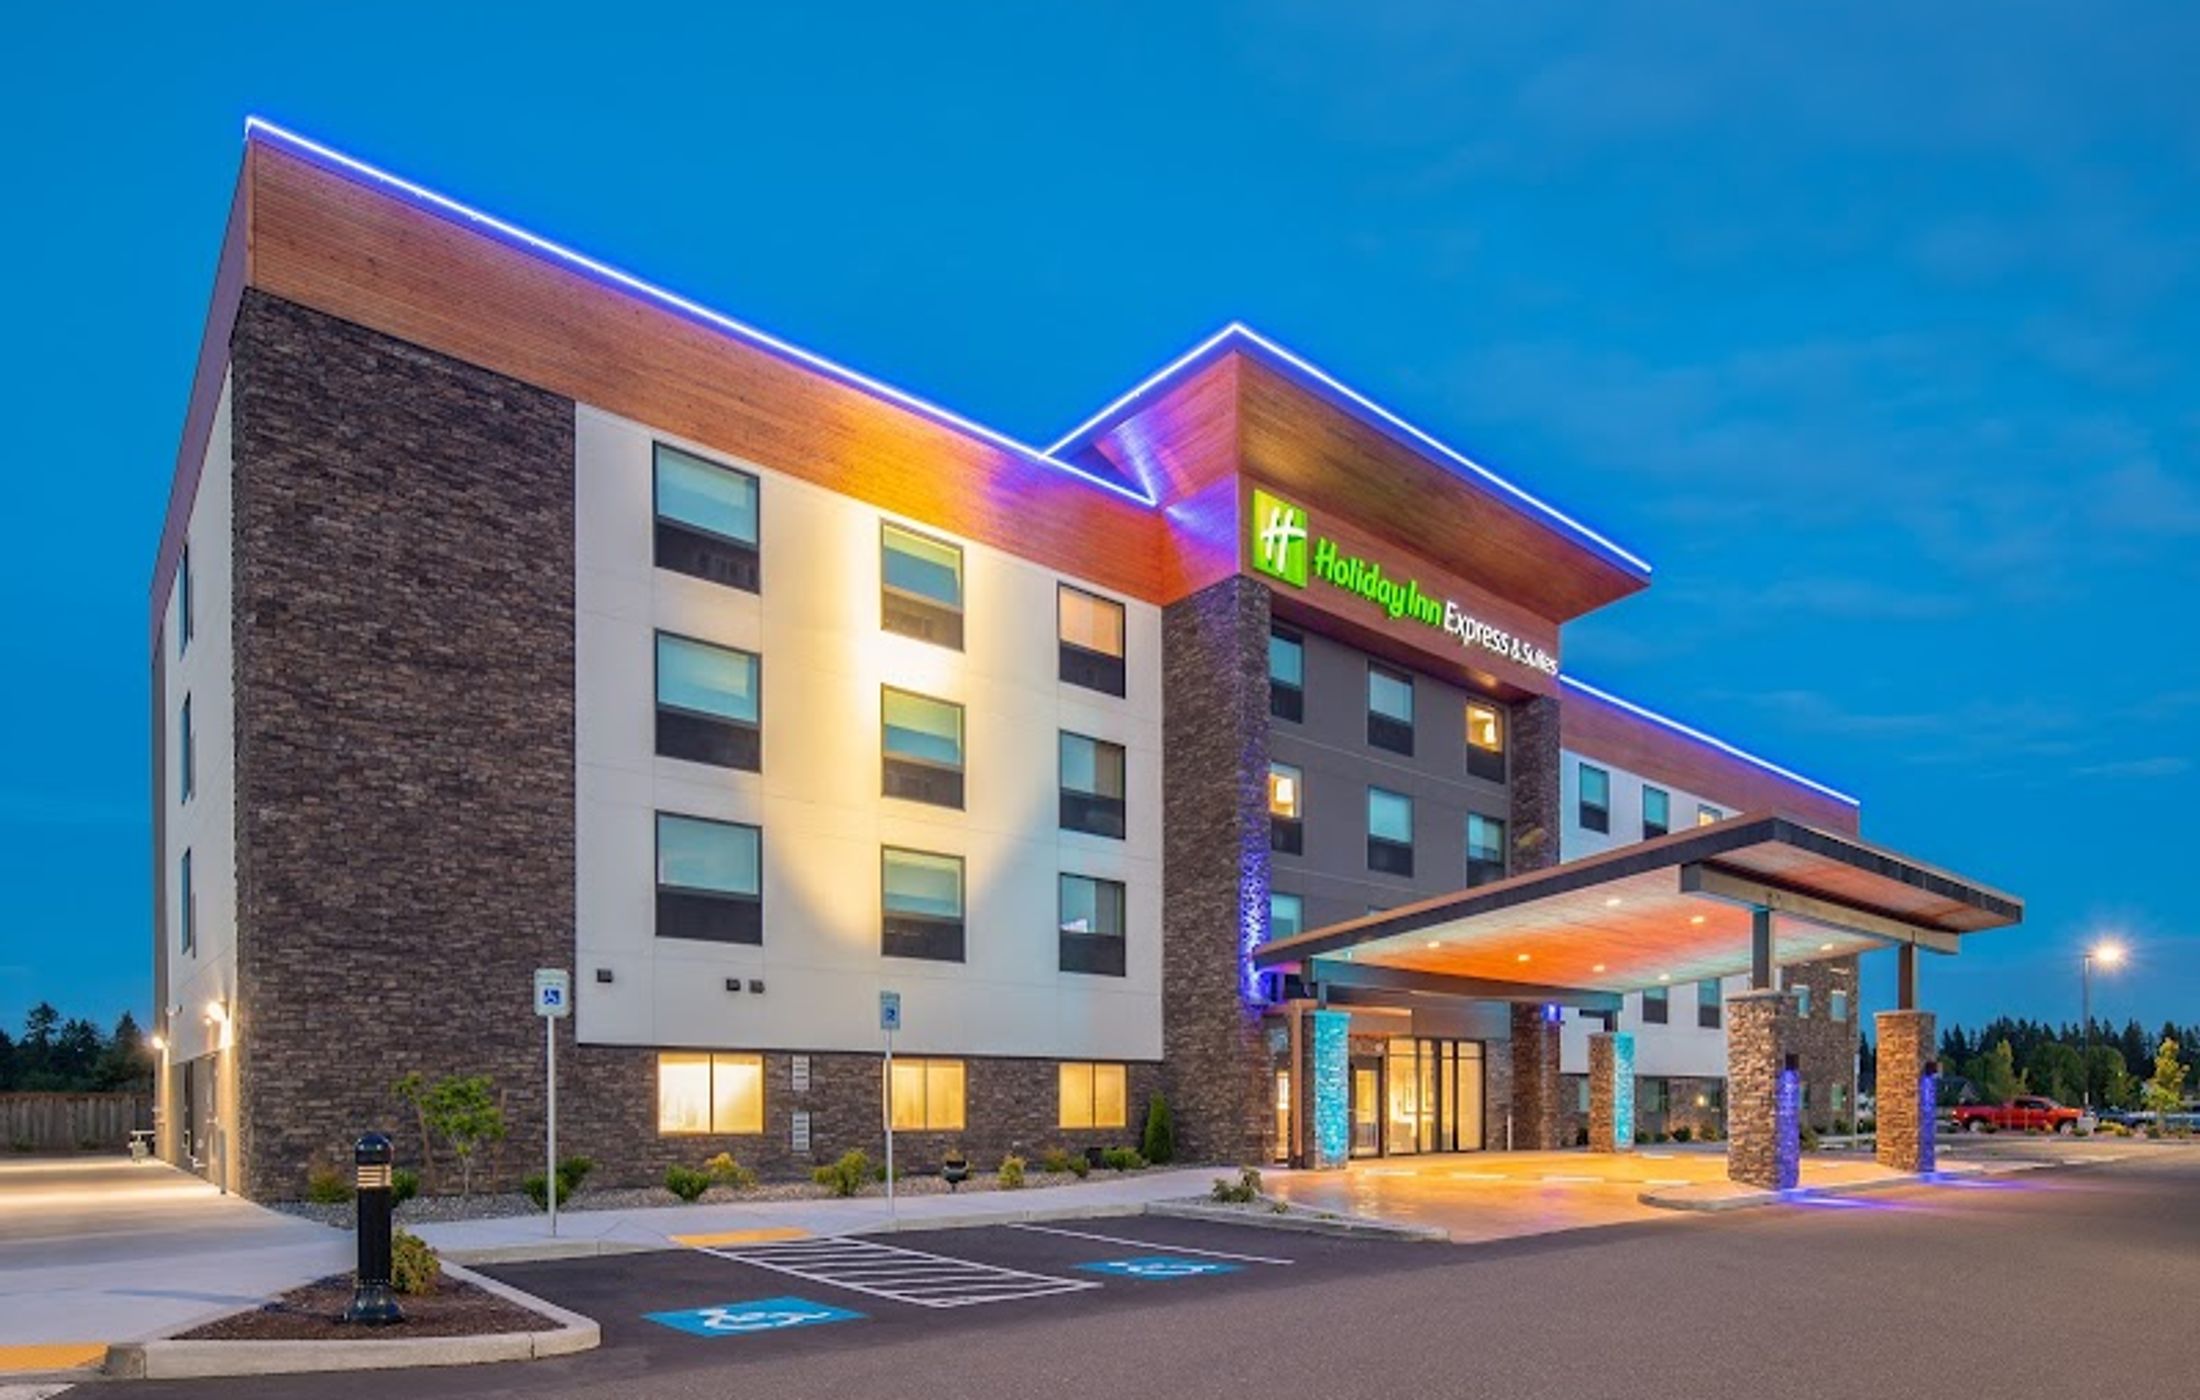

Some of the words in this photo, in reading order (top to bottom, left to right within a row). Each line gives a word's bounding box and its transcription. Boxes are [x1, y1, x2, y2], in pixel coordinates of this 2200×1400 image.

[1314, 537, 1405, 618] Holiday
[1407, 580, 1442, 626] Inn
[1444, 600, 1509, 655] Express
[1510, 638, 1521, 660] &
[1522, 643, 1558, 676] Suites
